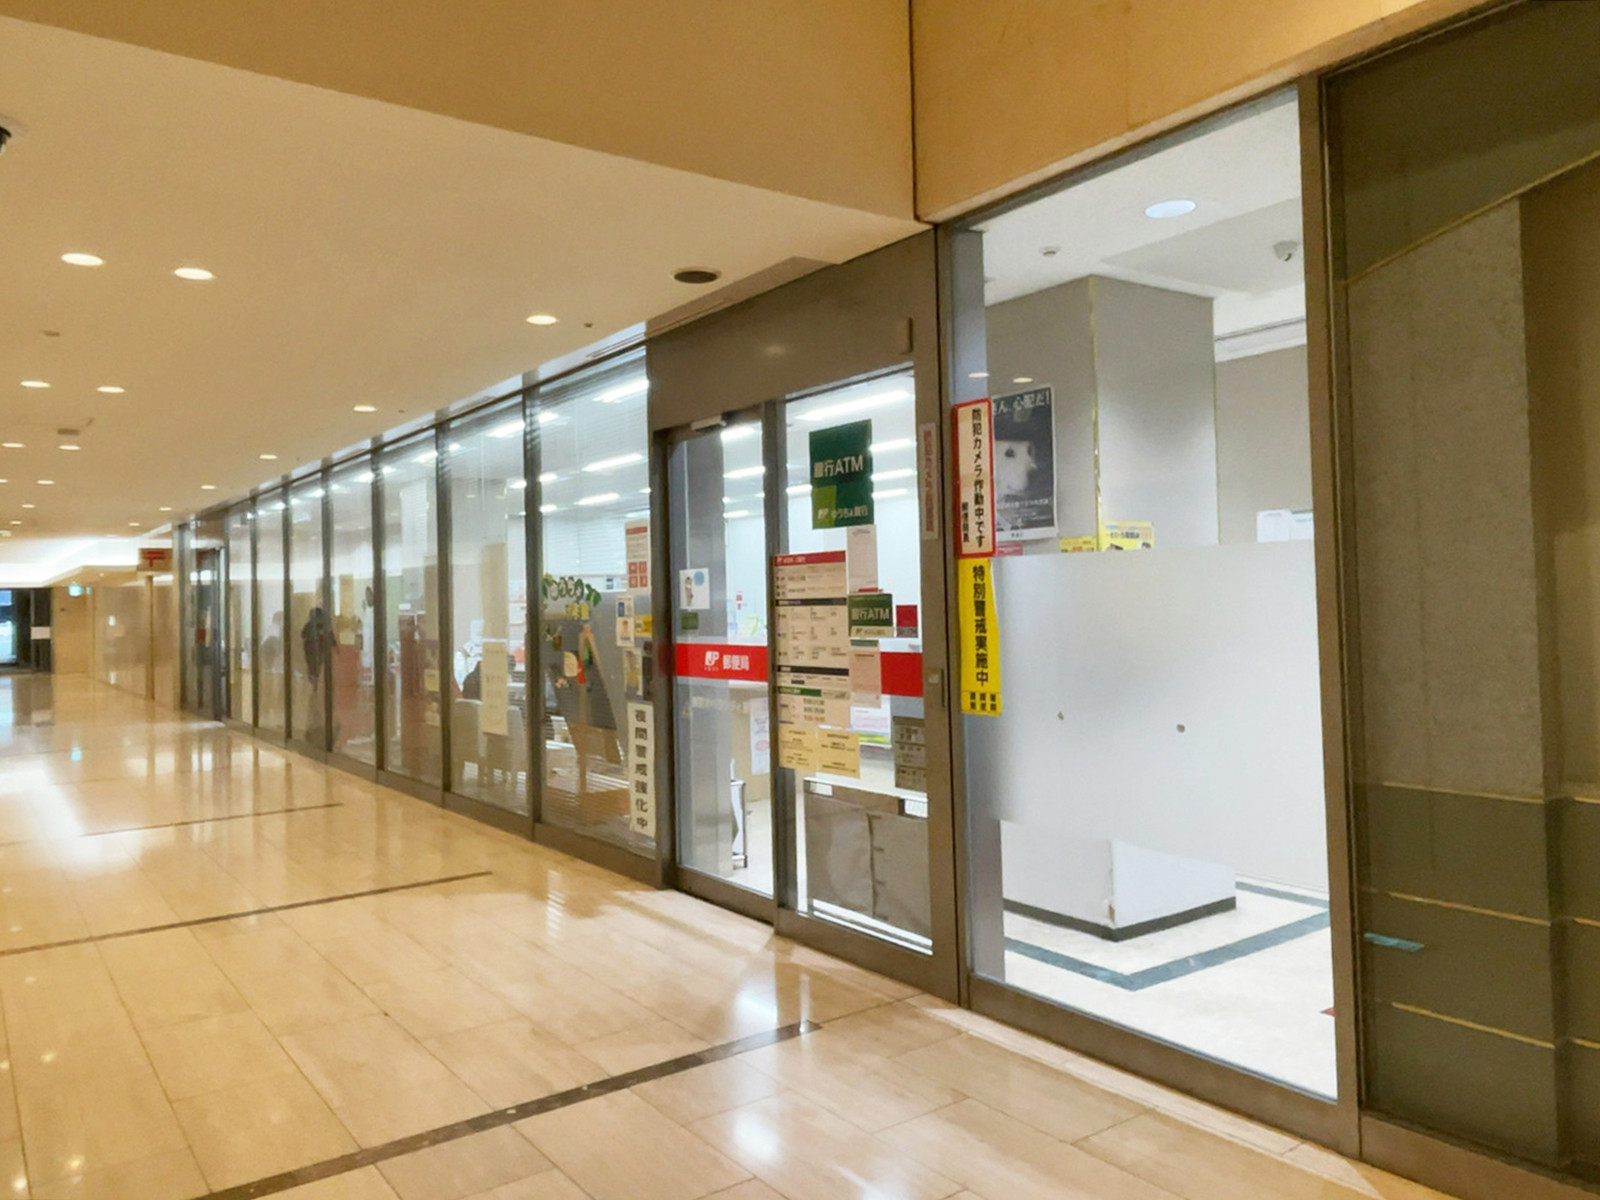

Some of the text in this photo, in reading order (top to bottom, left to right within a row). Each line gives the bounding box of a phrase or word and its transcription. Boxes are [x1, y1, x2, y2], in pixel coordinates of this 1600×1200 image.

[813, 454, 864, 478] 銀行ATM
[971, 408, 985, 548] 防犯カメラ作動中です
[851, 607, 890, 620] 銀行ATM
[973, 564, 989, 687] 特別警戒実施中
[723, 654, 750, 671] 郵便局
[635, 709, 649, 829] 夜間警戒強化中
